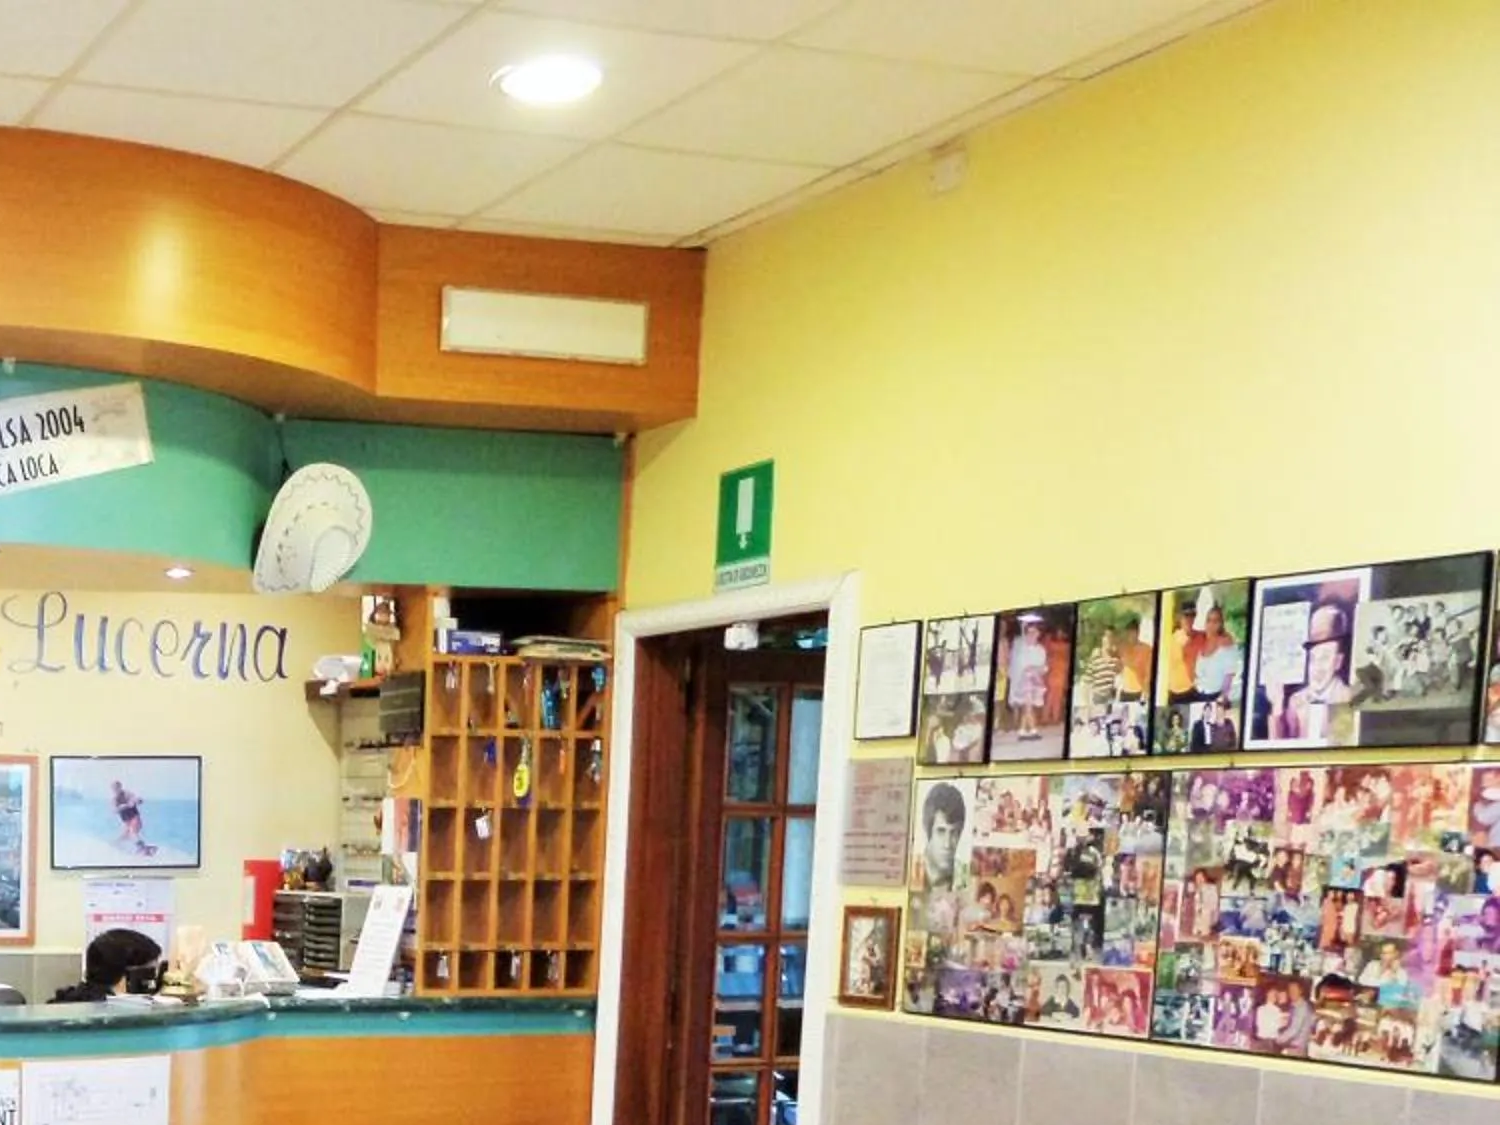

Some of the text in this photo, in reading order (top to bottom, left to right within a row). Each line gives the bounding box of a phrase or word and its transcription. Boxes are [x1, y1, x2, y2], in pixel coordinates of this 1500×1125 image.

[35, 404, 86, 441] 2004
[19, 452, 60, 482] LOCA
[0, 590, 289, 683] Lucerna
